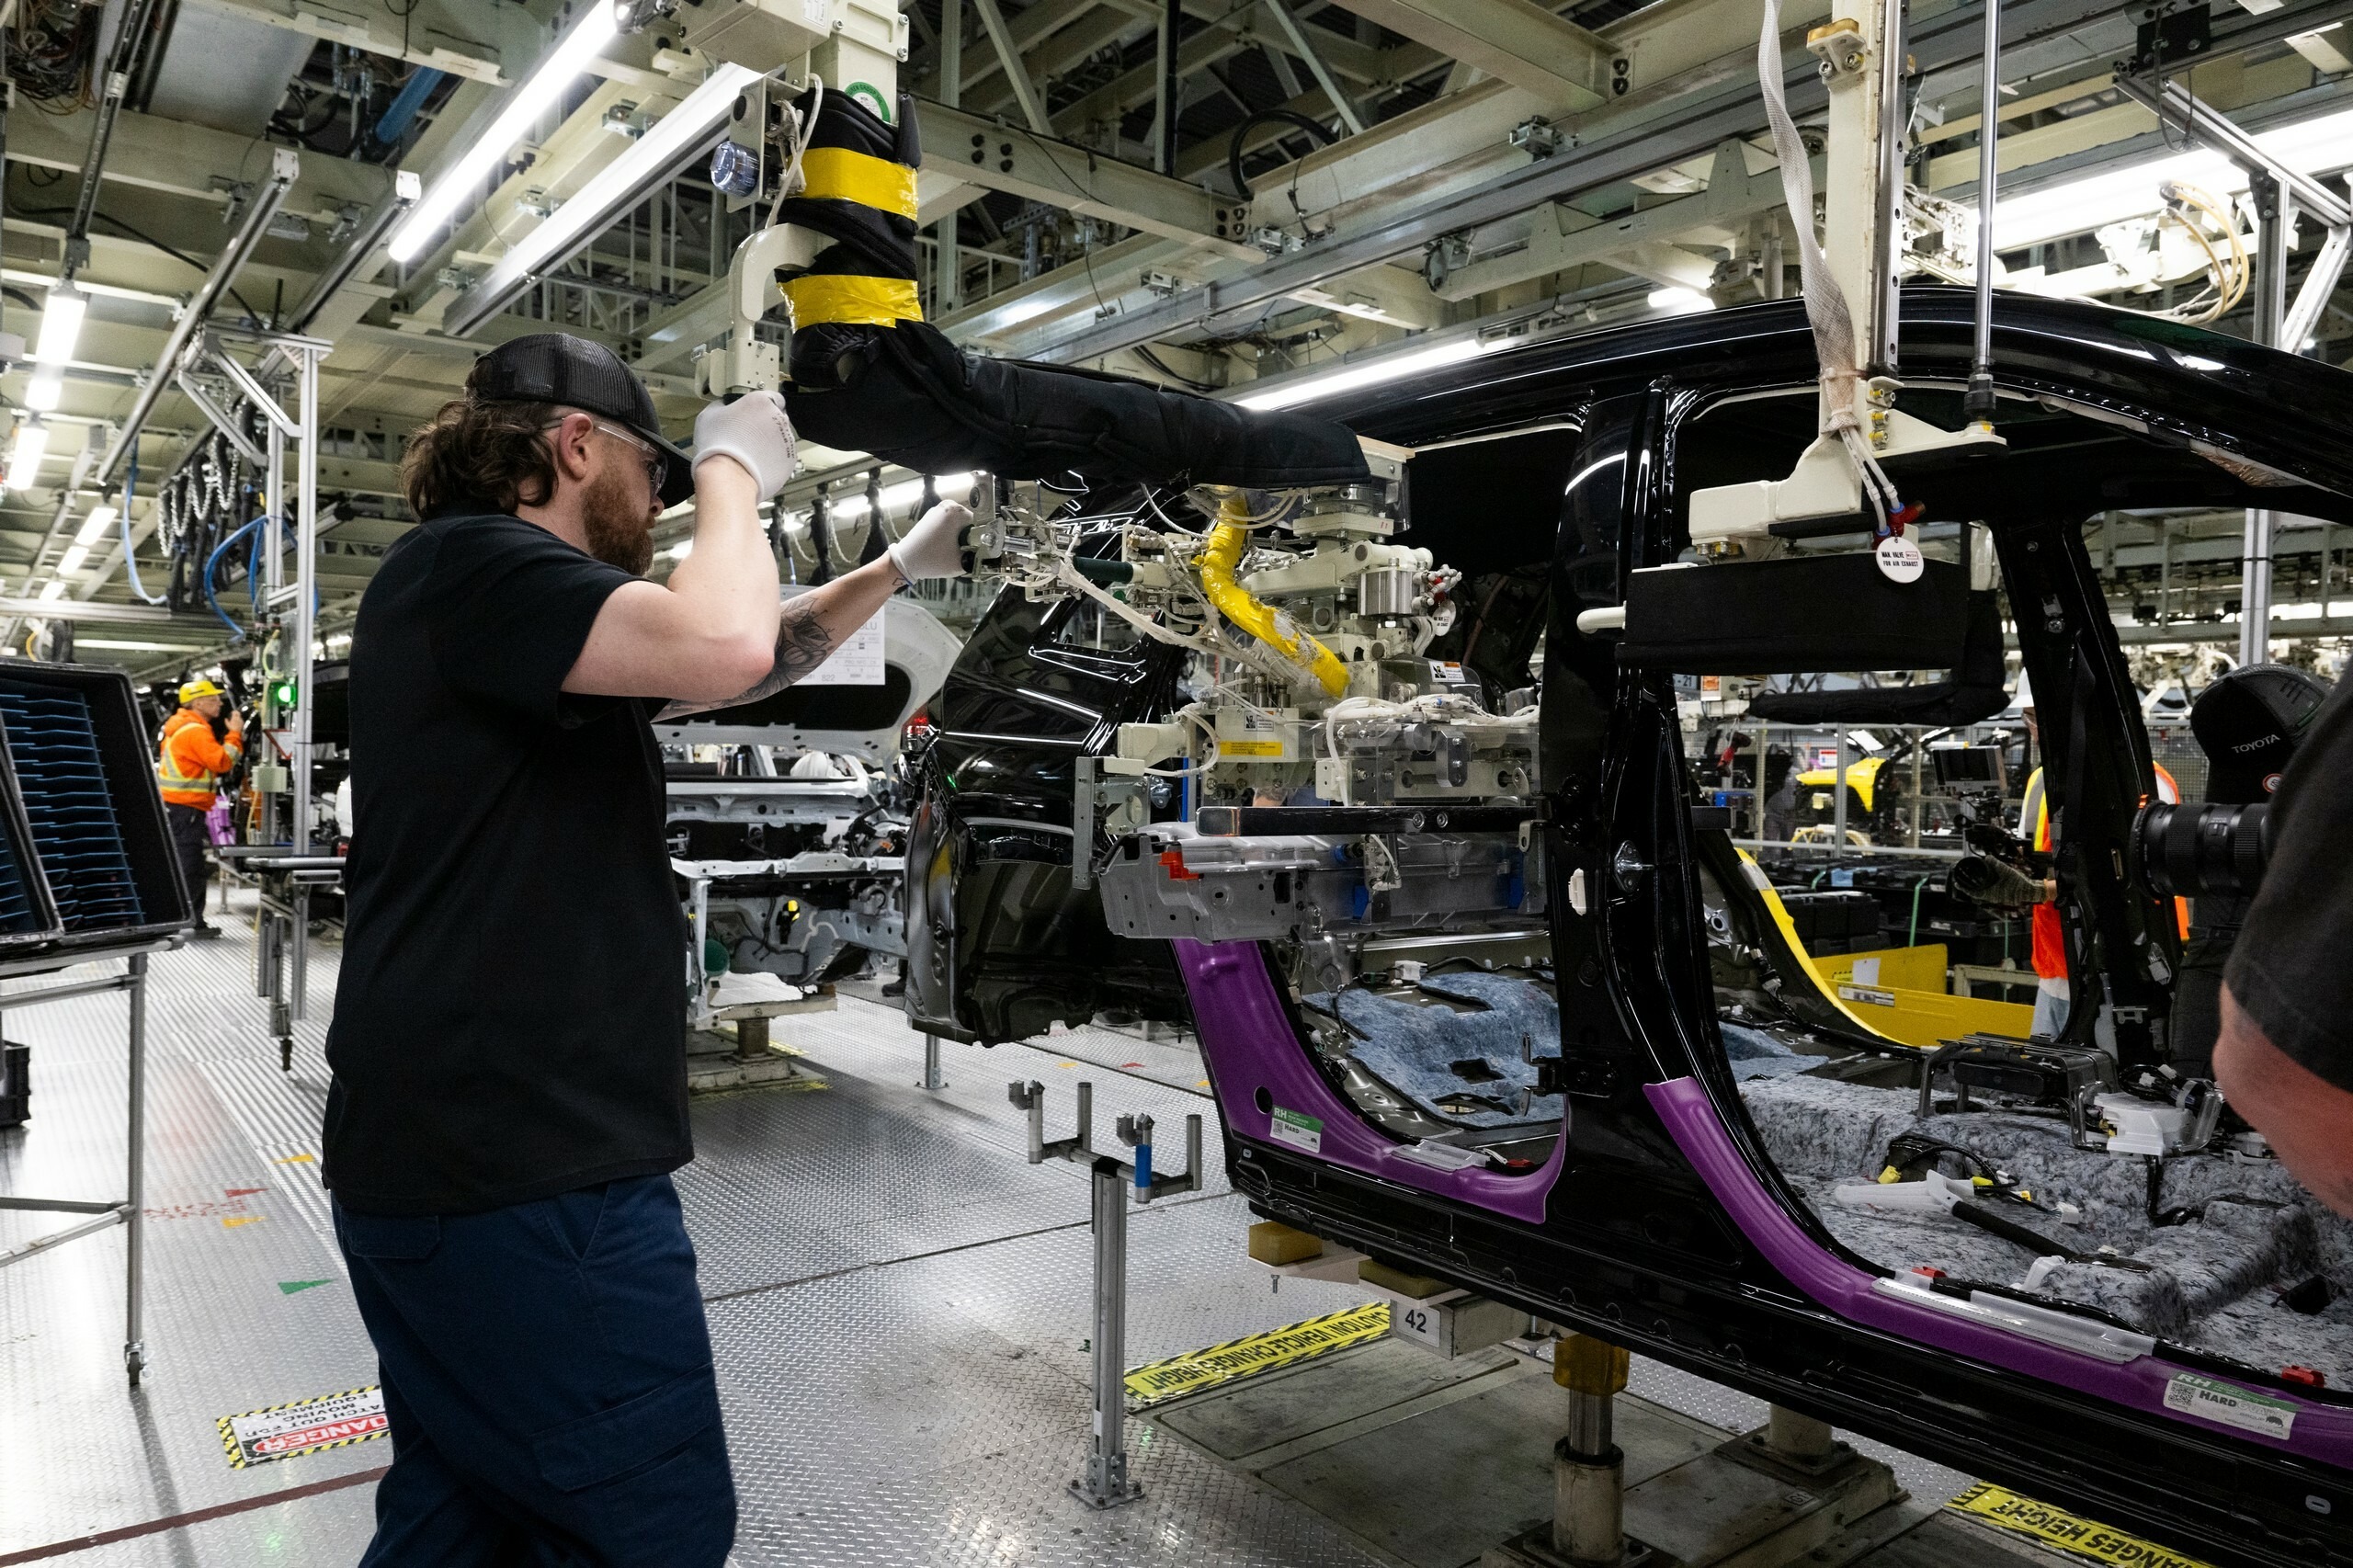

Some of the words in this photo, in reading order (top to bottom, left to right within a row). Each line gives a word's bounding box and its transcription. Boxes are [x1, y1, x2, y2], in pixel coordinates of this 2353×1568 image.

[2231, 734, 2280, 754] TOYOTA
[1274, 1107, 1287, 1119] RH
[1405, 1309, 1427, 1333] 42
[1267, 1328, 1332, 1354] VEHICLE
[1198, 1345, 1279, 1373] CHANGES
[1141, 1363, 1209, 1390] HEIGHT
[2177, 1374, 2211, 1387] RH
[263, 1393, 368, 1420] EQUIPMENT
[283, 1403, 356, 1422] MOVING
[334, 1404, 385, 1419] ATCH
[245, 1425, 284, 1437] FOR
[292, 1416, 326, 1427] OUT
[1989, 1500, 2091, 1545] HEIGHT
